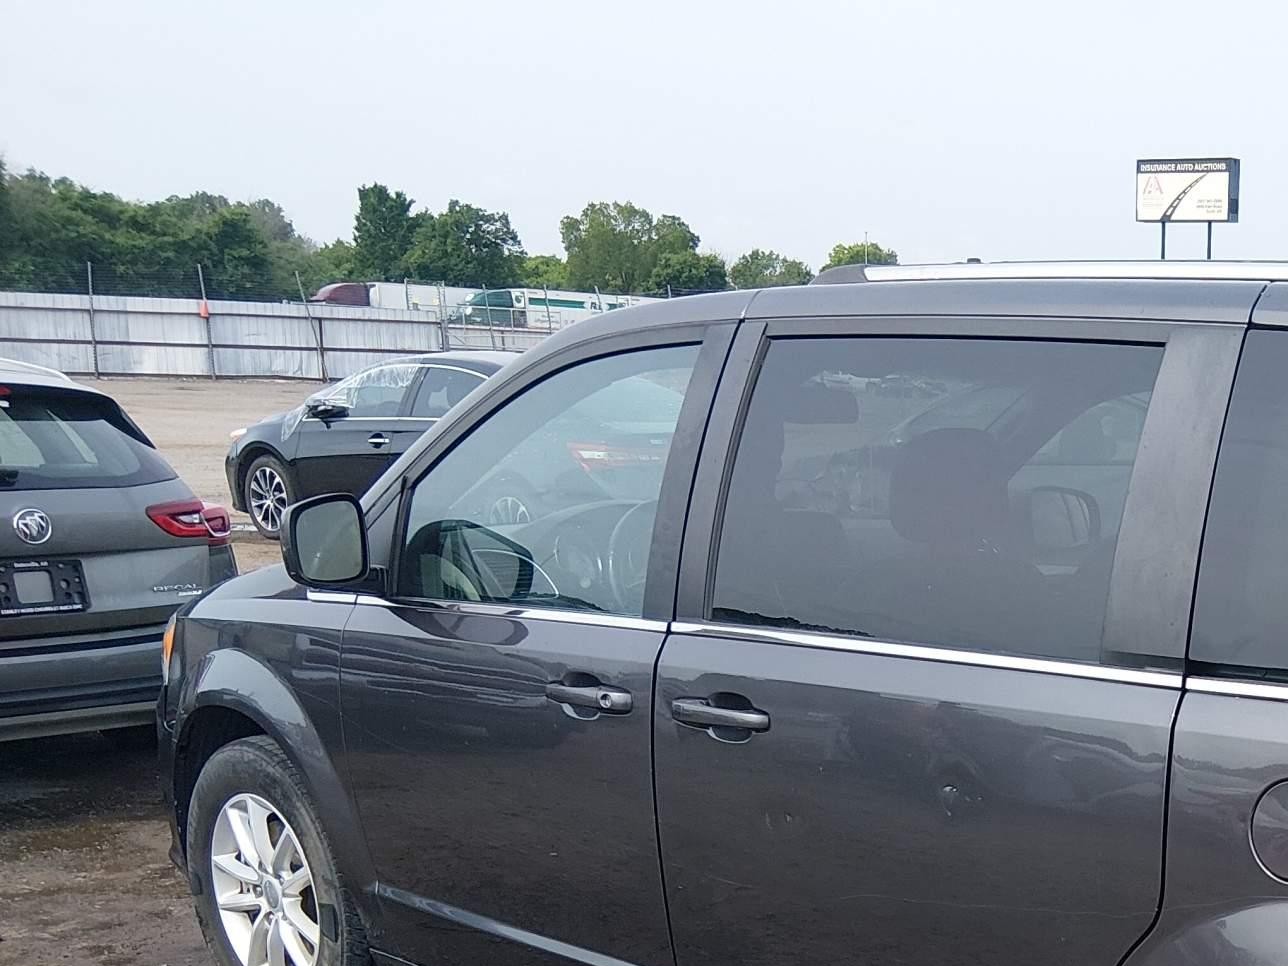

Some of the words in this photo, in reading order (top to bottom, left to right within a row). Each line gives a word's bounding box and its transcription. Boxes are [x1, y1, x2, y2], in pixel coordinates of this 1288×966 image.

[1140, 163, 1175, 172] INSURANCE
[1176, 163, 1193, 171] AUTO
[1194, 162, 1226, 171] AUCTIONS
